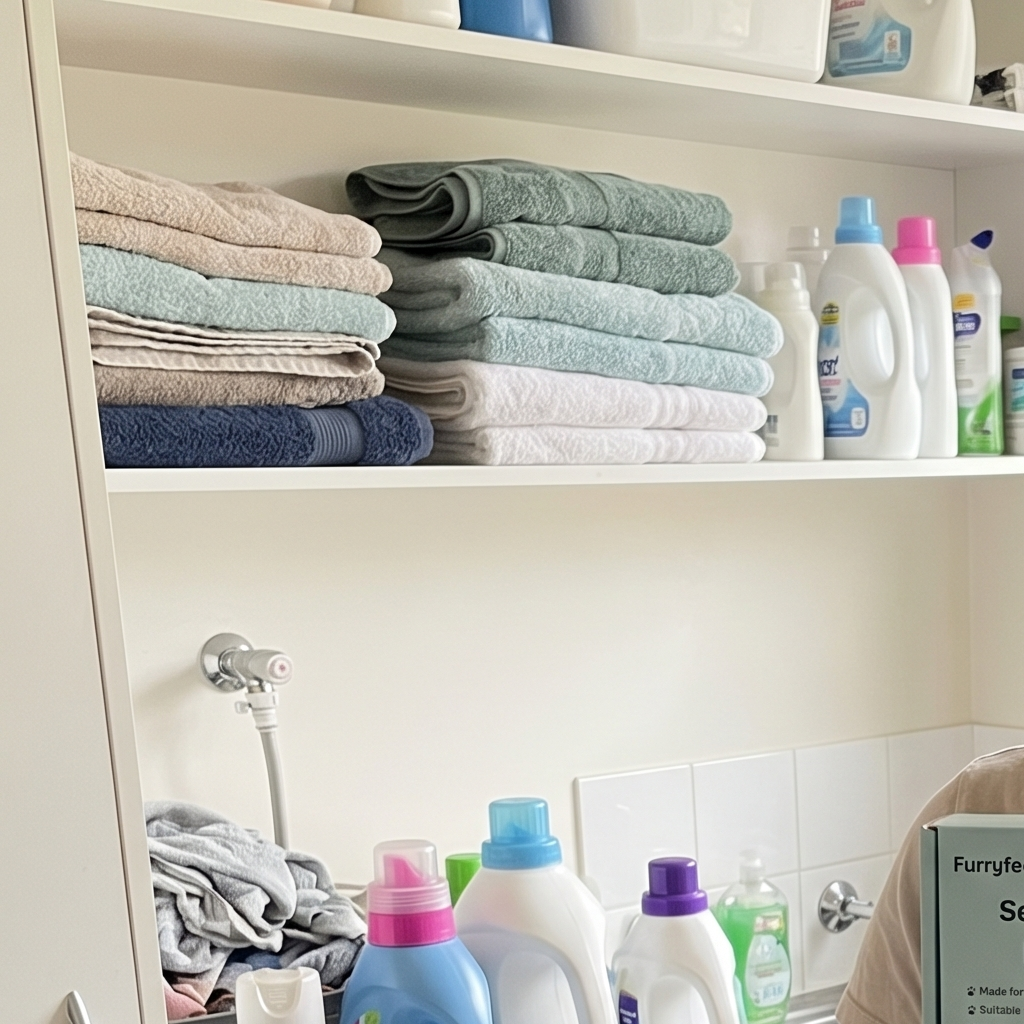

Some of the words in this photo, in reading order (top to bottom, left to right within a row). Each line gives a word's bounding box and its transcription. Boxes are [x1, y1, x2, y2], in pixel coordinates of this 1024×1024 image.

[979, 986, 1007, 997] Made
[1009, 986, 1024, 997] for
[979, 1004, 1021, 1016] Suitable
